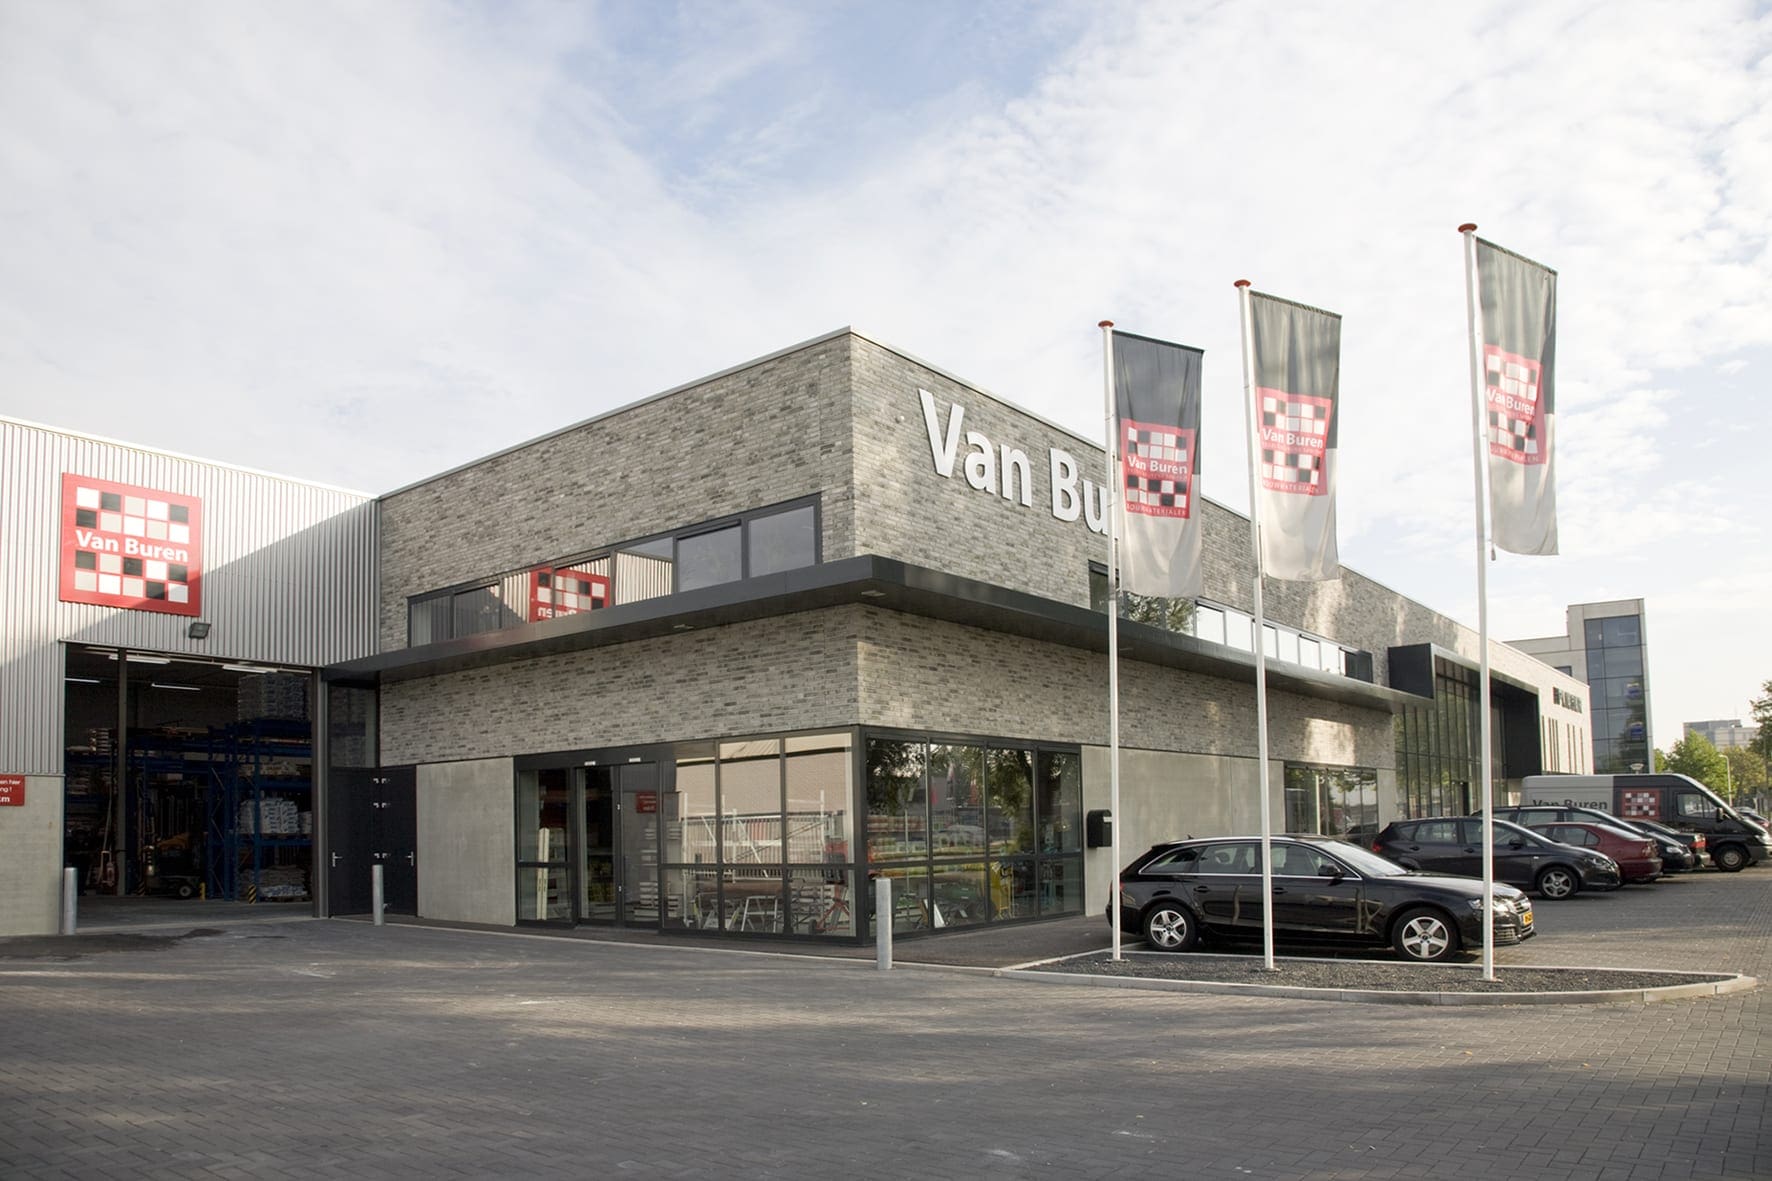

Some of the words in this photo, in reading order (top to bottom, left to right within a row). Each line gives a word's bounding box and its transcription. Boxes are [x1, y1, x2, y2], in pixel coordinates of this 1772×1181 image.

[919, 388, 1032, 508] Van
[1262, 427, 1284, 443] Van
[1286, 432, 1323, 448] Buren
[1127, 455, 1147, 471] Van
[1150, 459, 1187, 474] Buren
[75, 529, 119, 552] Van
[124, 537, 188, 562] Buren
